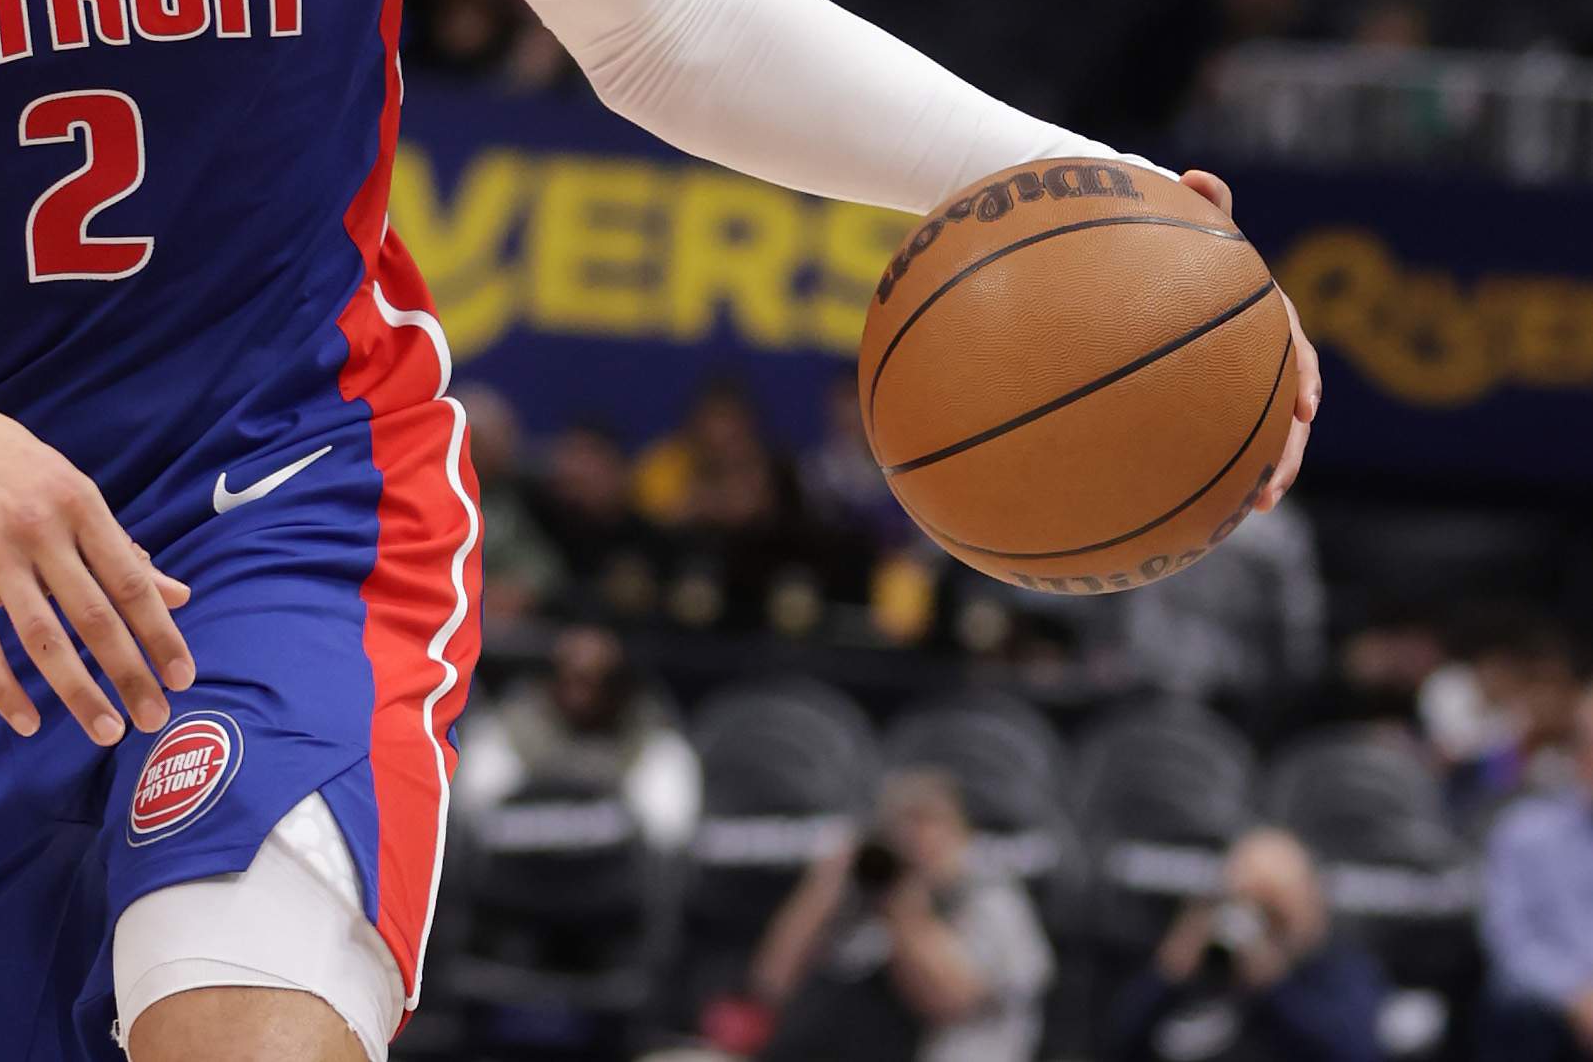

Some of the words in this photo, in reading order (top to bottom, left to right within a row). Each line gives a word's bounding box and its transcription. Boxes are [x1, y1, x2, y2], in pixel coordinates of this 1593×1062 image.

[19, 89, 155, 283] 2
[877, 164, 1145, 306] Wilson
[139, 765, 209, 809] PISTONS
[146, 745, 215, 787] DETROIT
